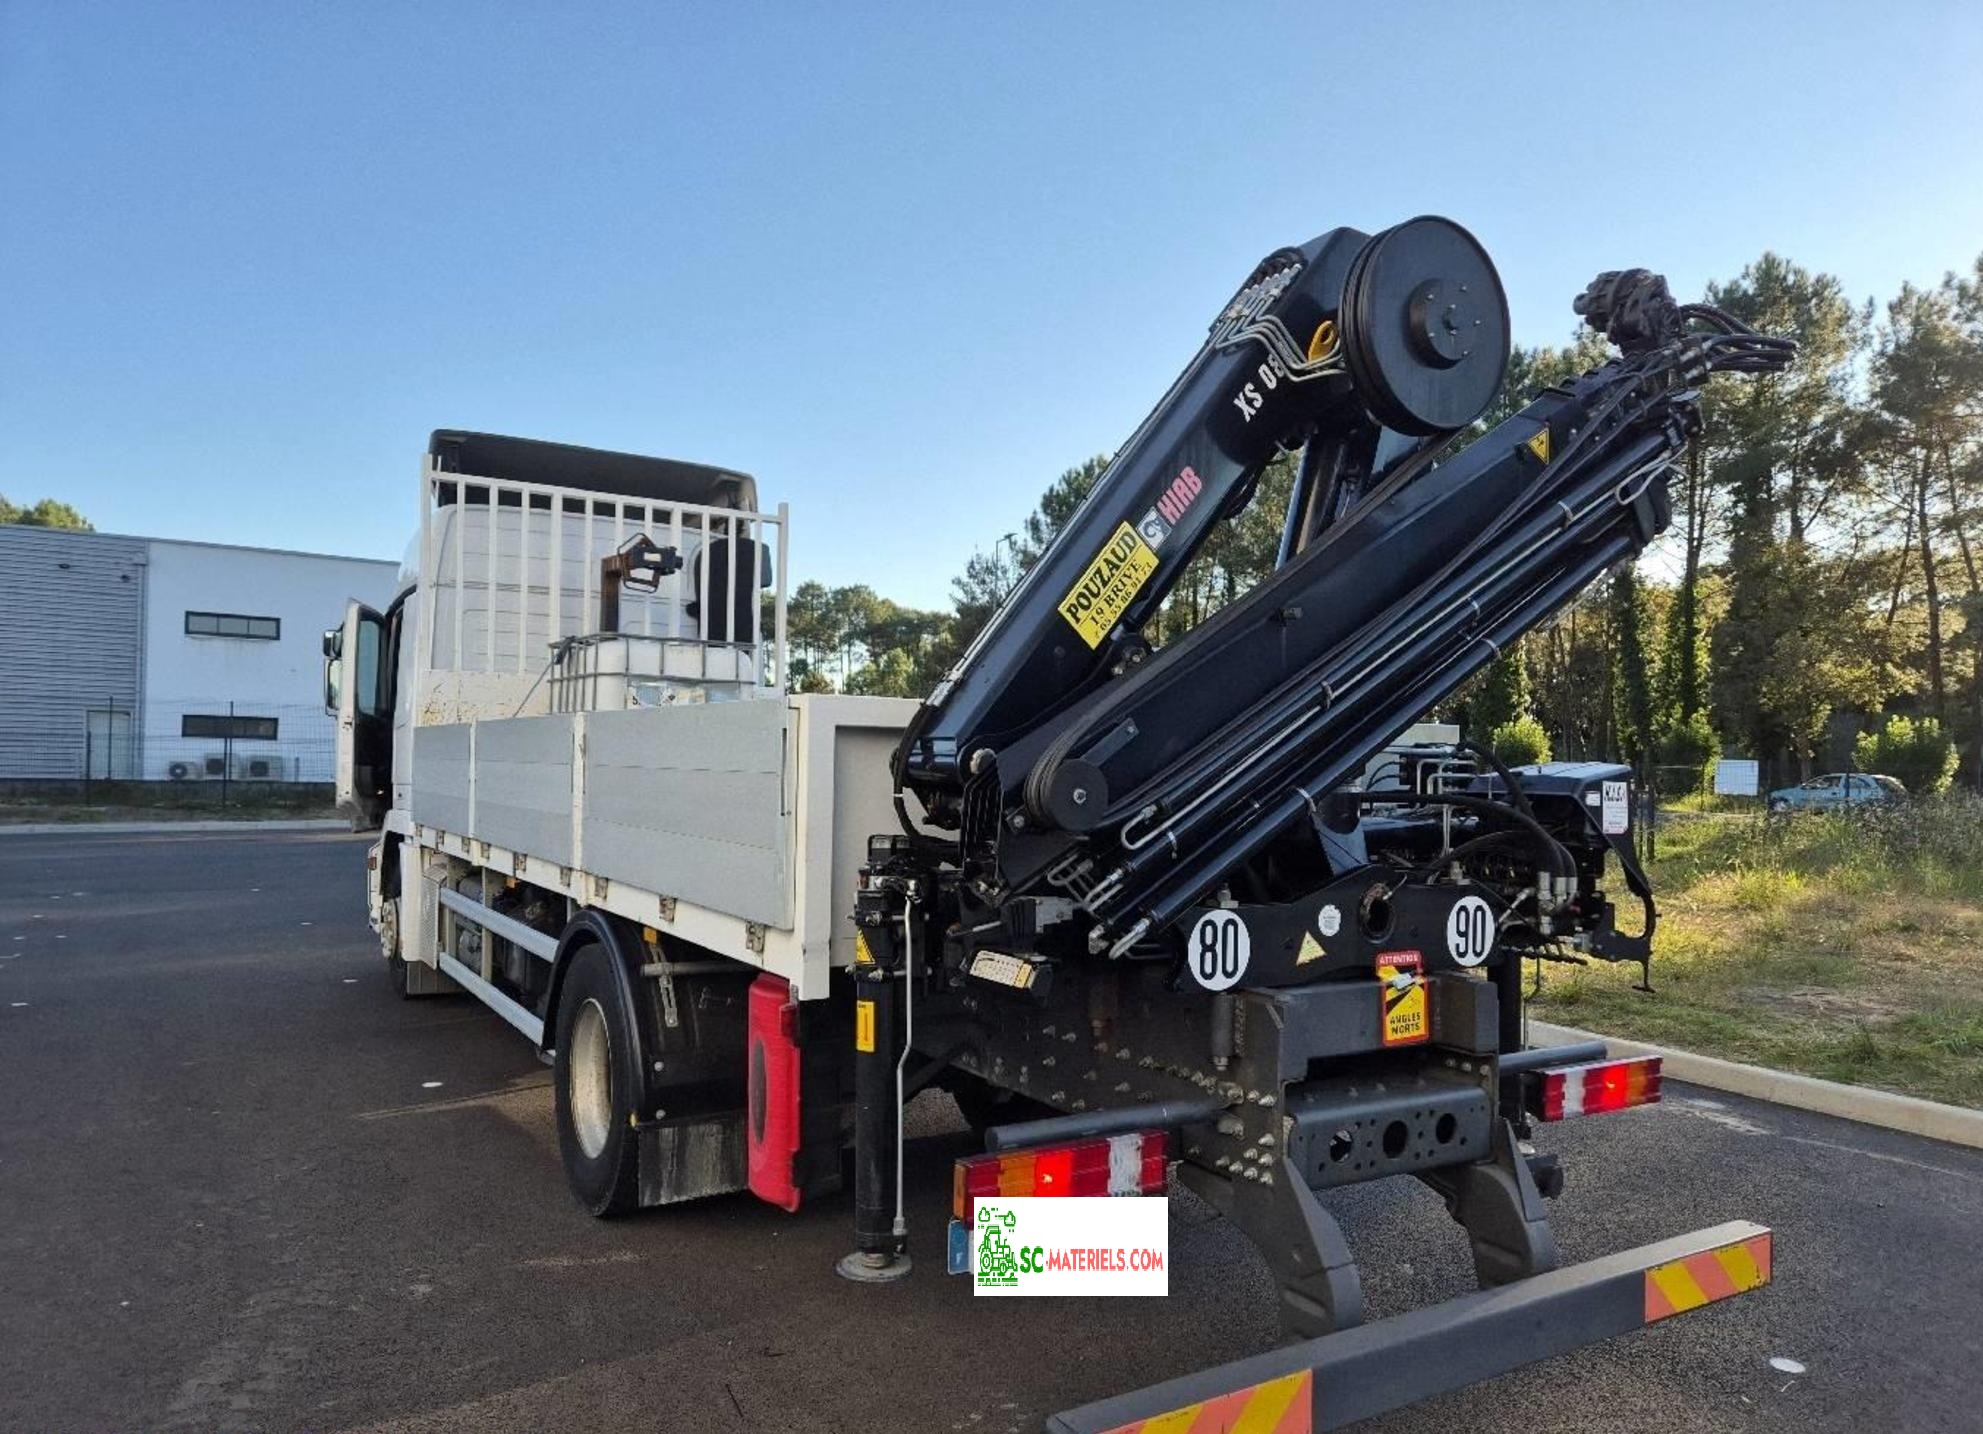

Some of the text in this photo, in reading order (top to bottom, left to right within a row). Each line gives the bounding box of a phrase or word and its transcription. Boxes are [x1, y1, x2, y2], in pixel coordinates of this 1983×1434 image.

[1233, 382, 1263, 422] XS
[1157, 466, 1202, 526] HIAB
[1066, 531, 1138, 624] POUZAUD
[1091, 559, 1142, 626] 19 BRIVE
[1200, 918, 1239, 981] 80
[1380, 953, 1419, 965] ATTENTION
[1455, 904, 1487, 959] 90
[1390, 1011, 1421, 1025] ANGLES
[1391, 1022, 1420, 1035] MORTS
